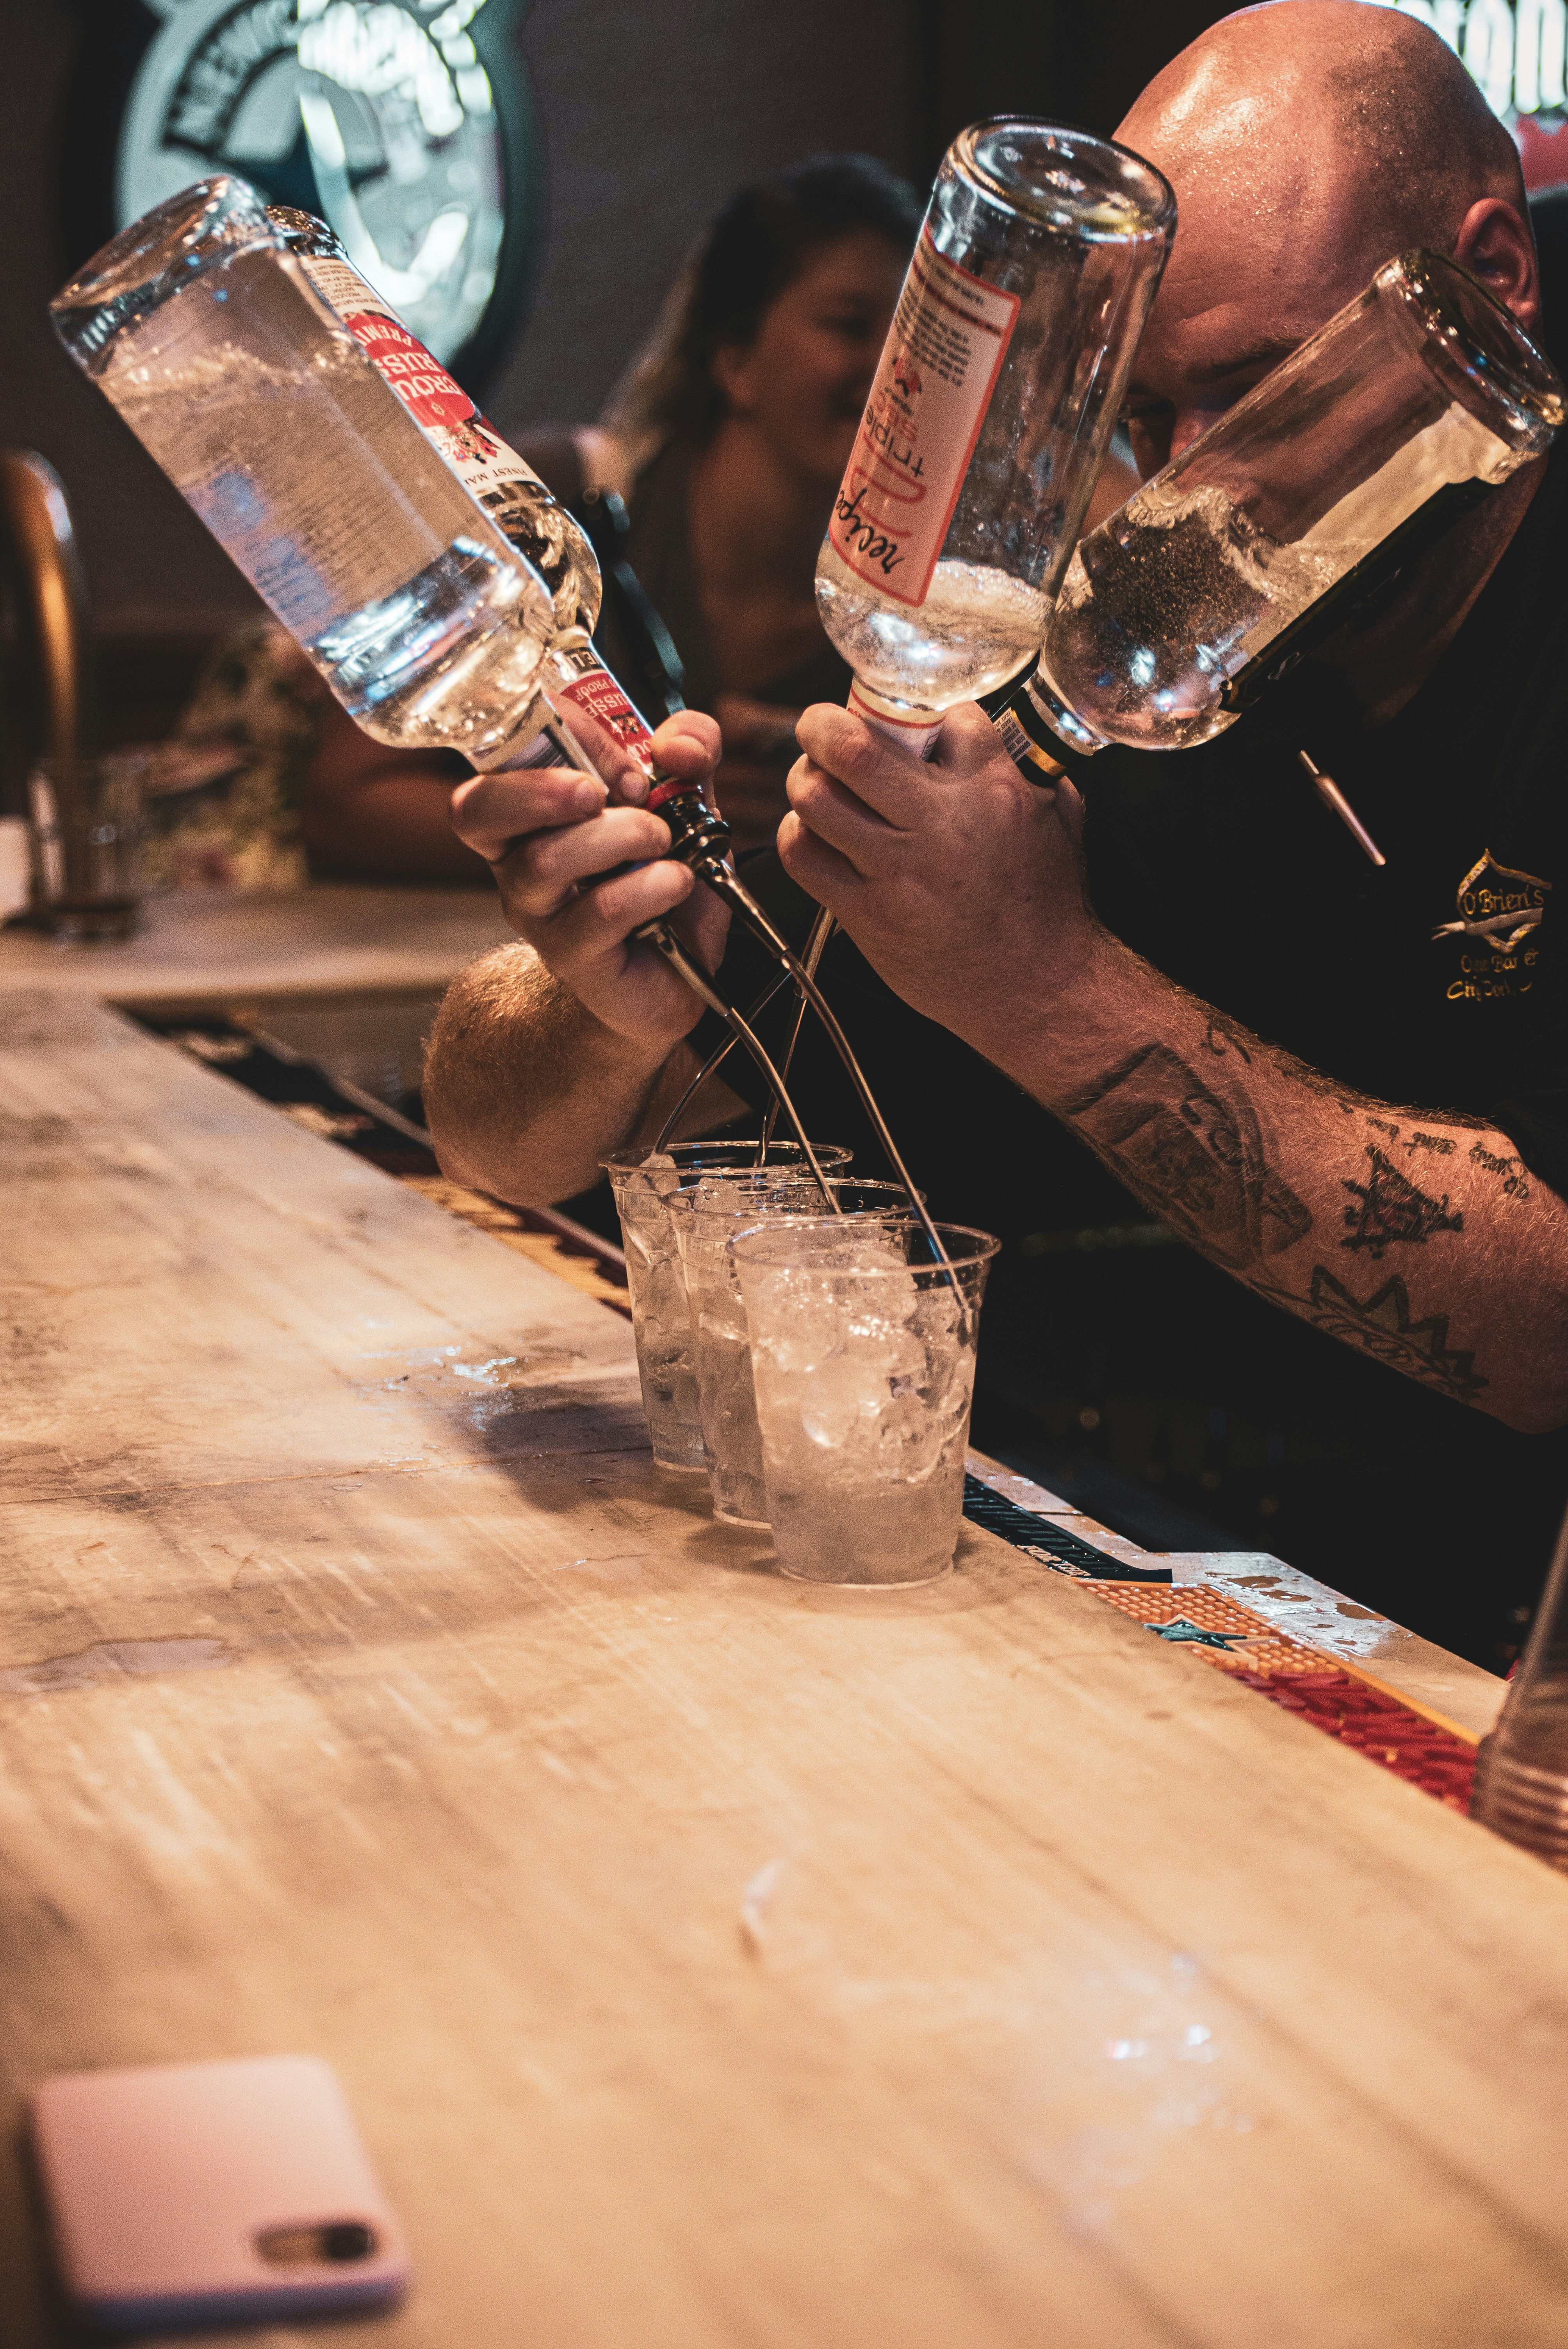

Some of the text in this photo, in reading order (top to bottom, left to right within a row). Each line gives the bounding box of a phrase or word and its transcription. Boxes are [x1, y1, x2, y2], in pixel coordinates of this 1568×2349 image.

[866, 405, 925, 478] triple
[492, 467, 528, 478] FINEST
[836, 487, 905, 574] recipe
[576, 679, 610, 701] PROOF
[1464, 884, 1544, 915] O'Brien's
